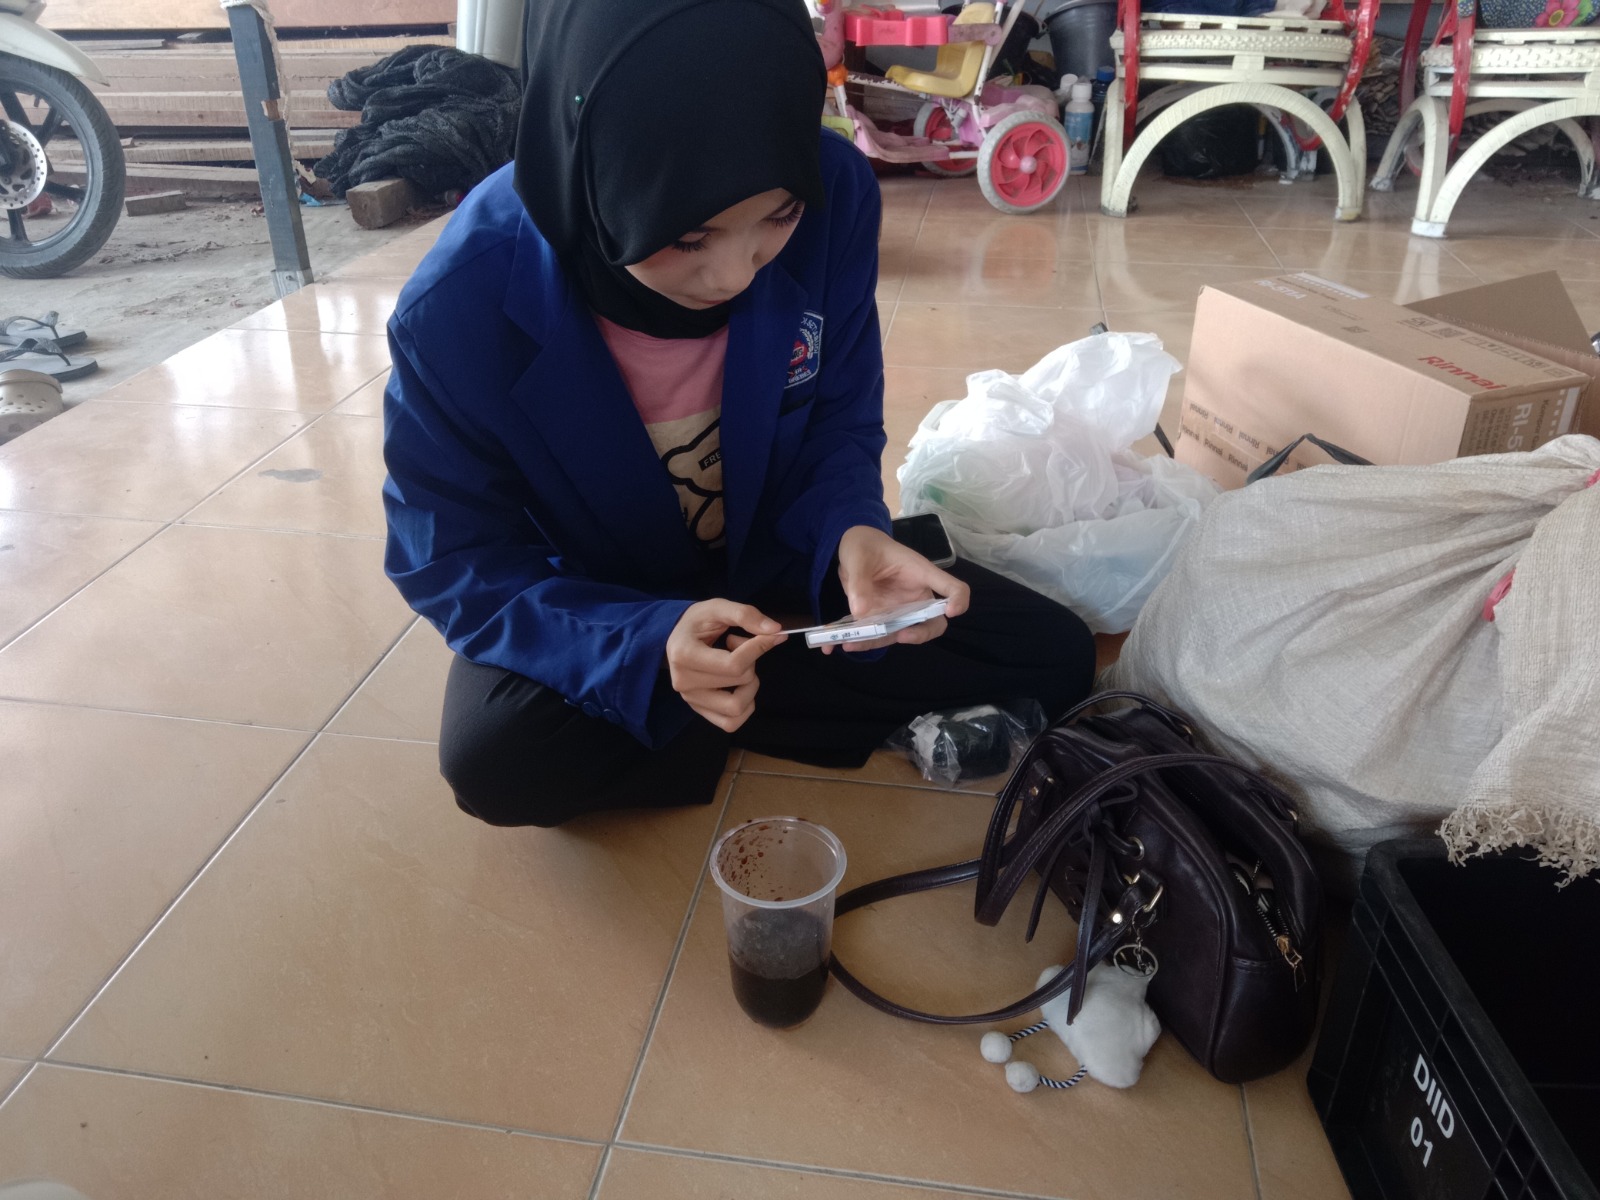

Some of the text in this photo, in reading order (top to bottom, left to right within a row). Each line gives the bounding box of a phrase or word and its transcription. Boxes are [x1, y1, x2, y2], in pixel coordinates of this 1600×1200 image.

[1417, 355, 1508, 390] Rinnai
[1507, 403, 1533, 453] RI-5
[1413, 1053, 1455, 1139] DIID
[1410, 1116, 1433, 1168] 01
